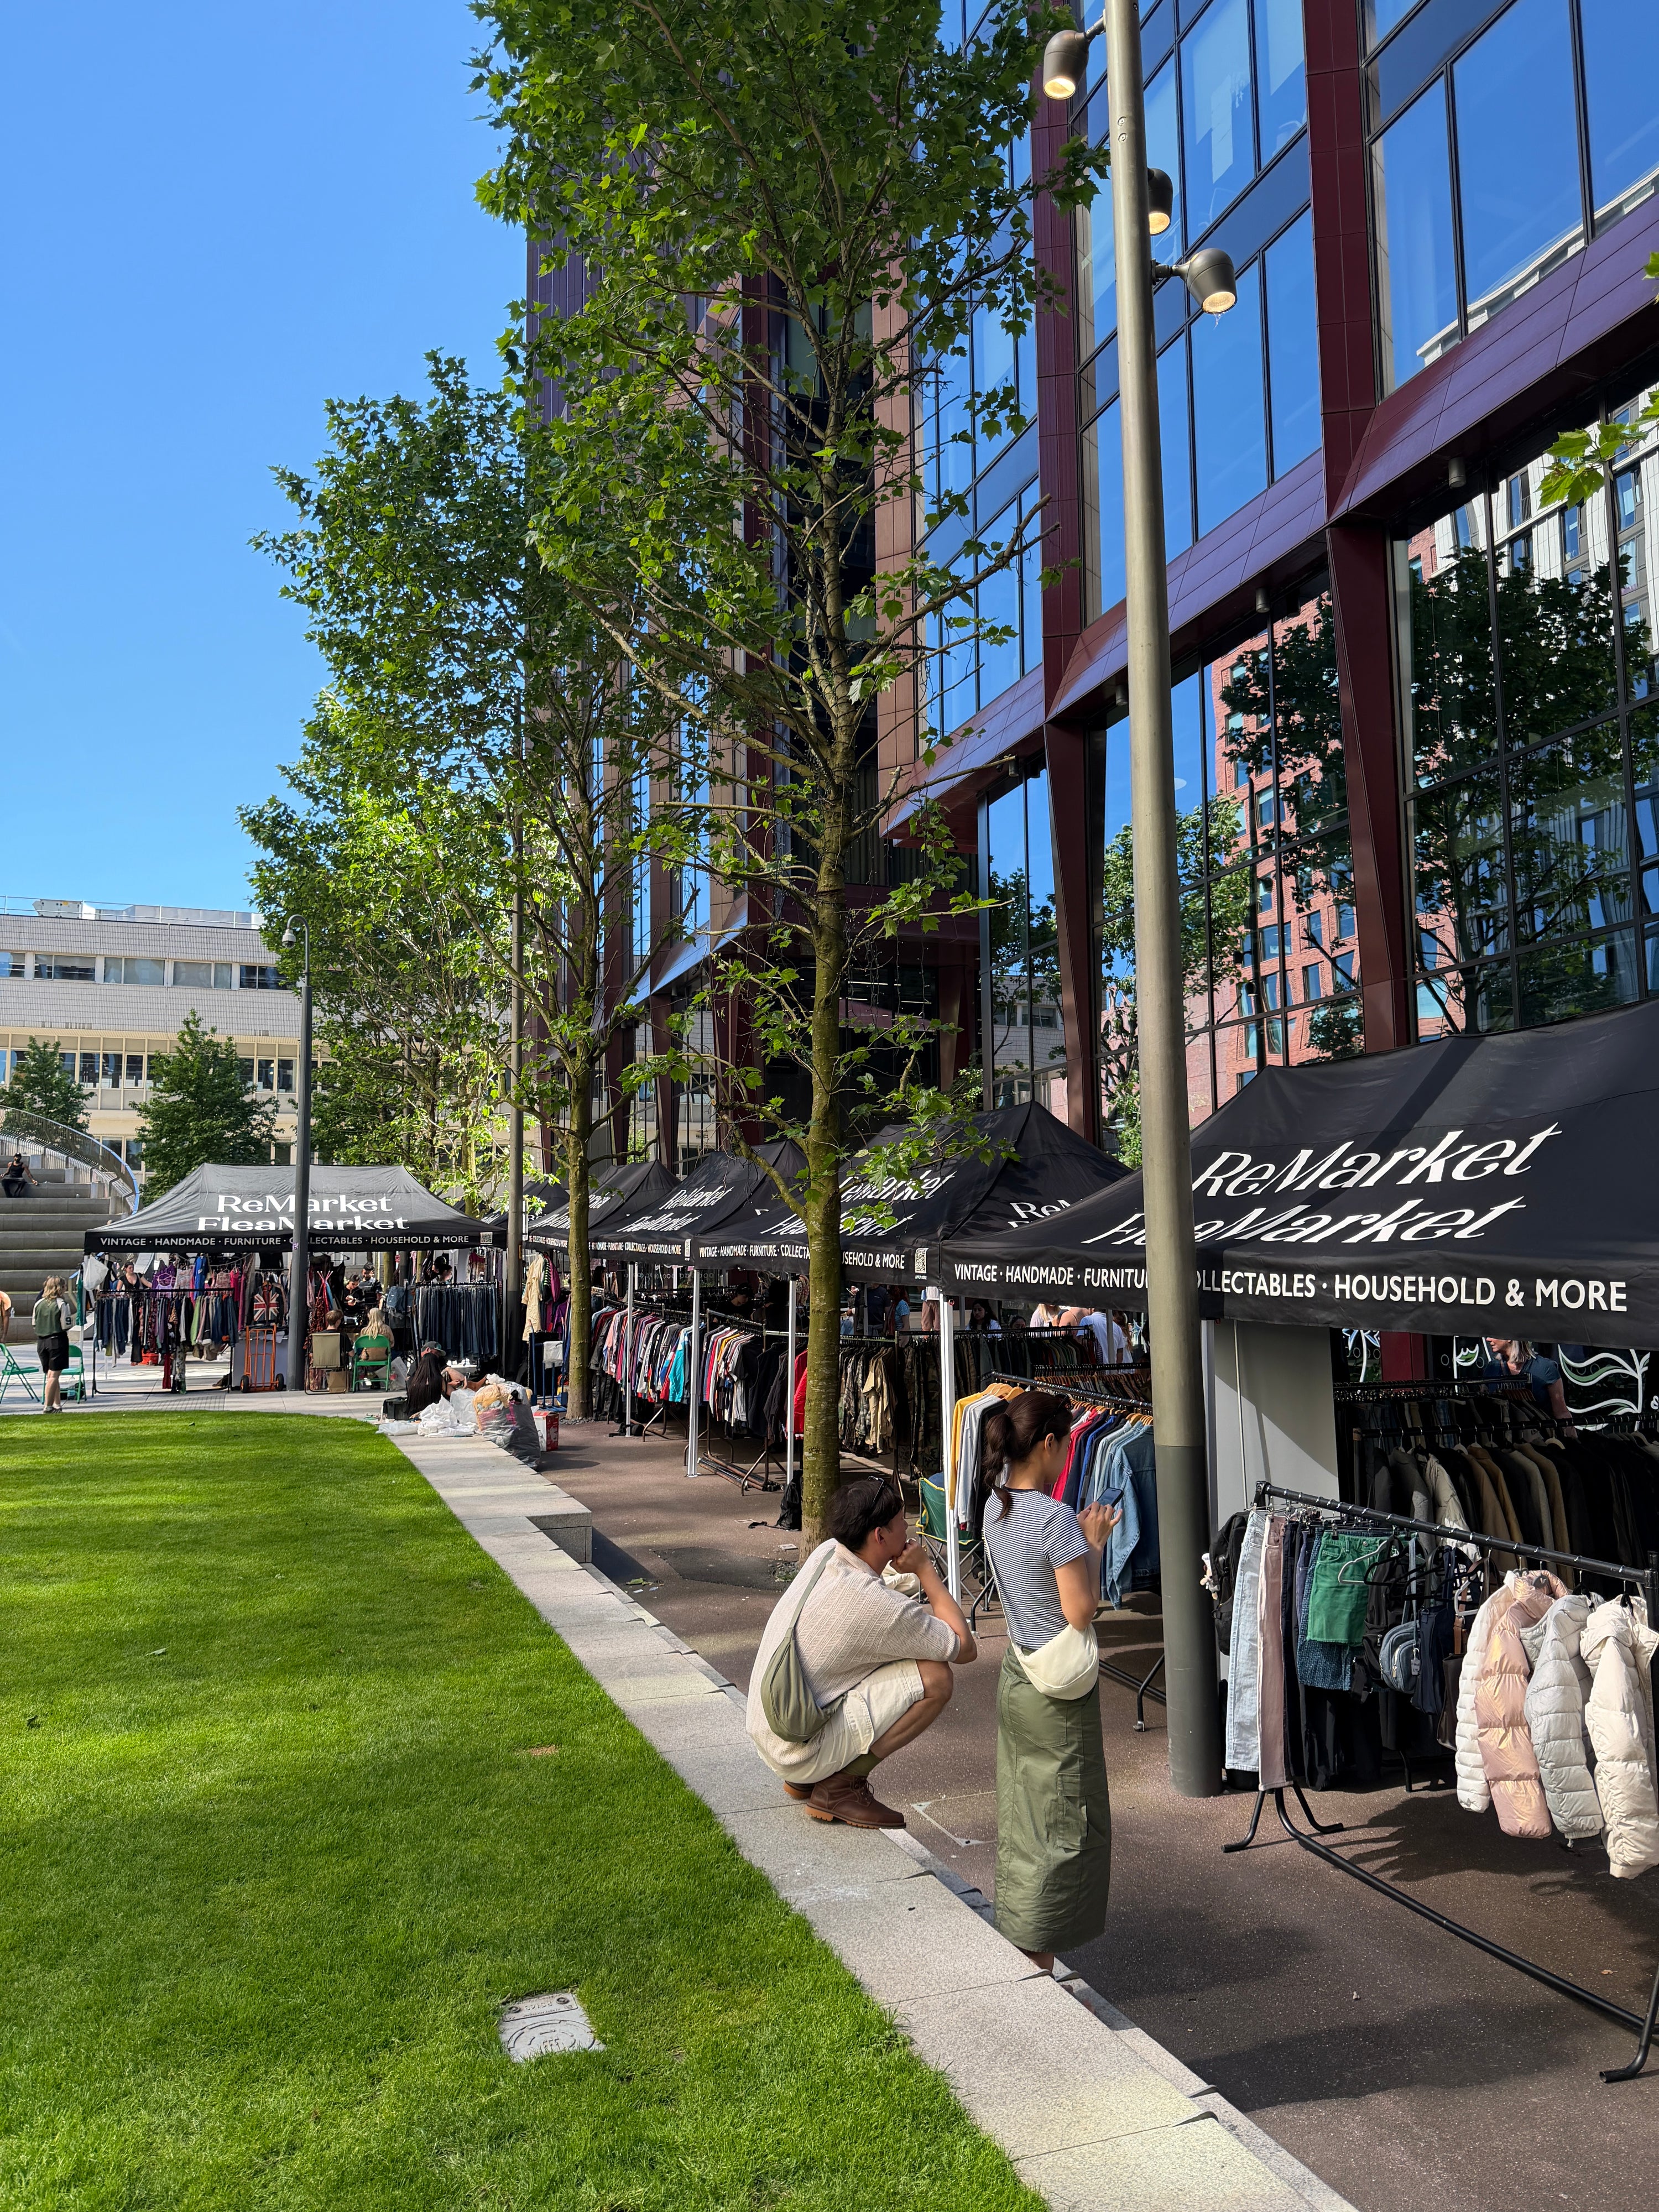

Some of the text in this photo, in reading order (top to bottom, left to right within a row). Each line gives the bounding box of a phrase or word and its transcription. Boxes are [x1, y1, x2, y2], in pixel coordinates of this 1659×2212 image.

[1192, 1122, 1562, 1196] ReMarket
[217, 1194, 393, 1213] ReMarket
[1081, 1196, 1526, 1245] FlaMarket
[648, 1244, 667, 1254] HOUSEHOLD
[671, 1244, 681, 1255] MORE
[699, 1246, 717, 1258] VINTAGE
[720, 1245, 747, 1257] HANDMADE
[749, 1245, 777, 1257] FURNITURE
[780, 1244, 811, 1260] COLLECTA
[875, 1256, 880, 1267] &
[883, 1254, 905, 1269] MORE
[954, 1264, 1627, 1312] VINTAGE HANDMADE FURNITU LLECTABLES HOUSEHOLD & MORE
